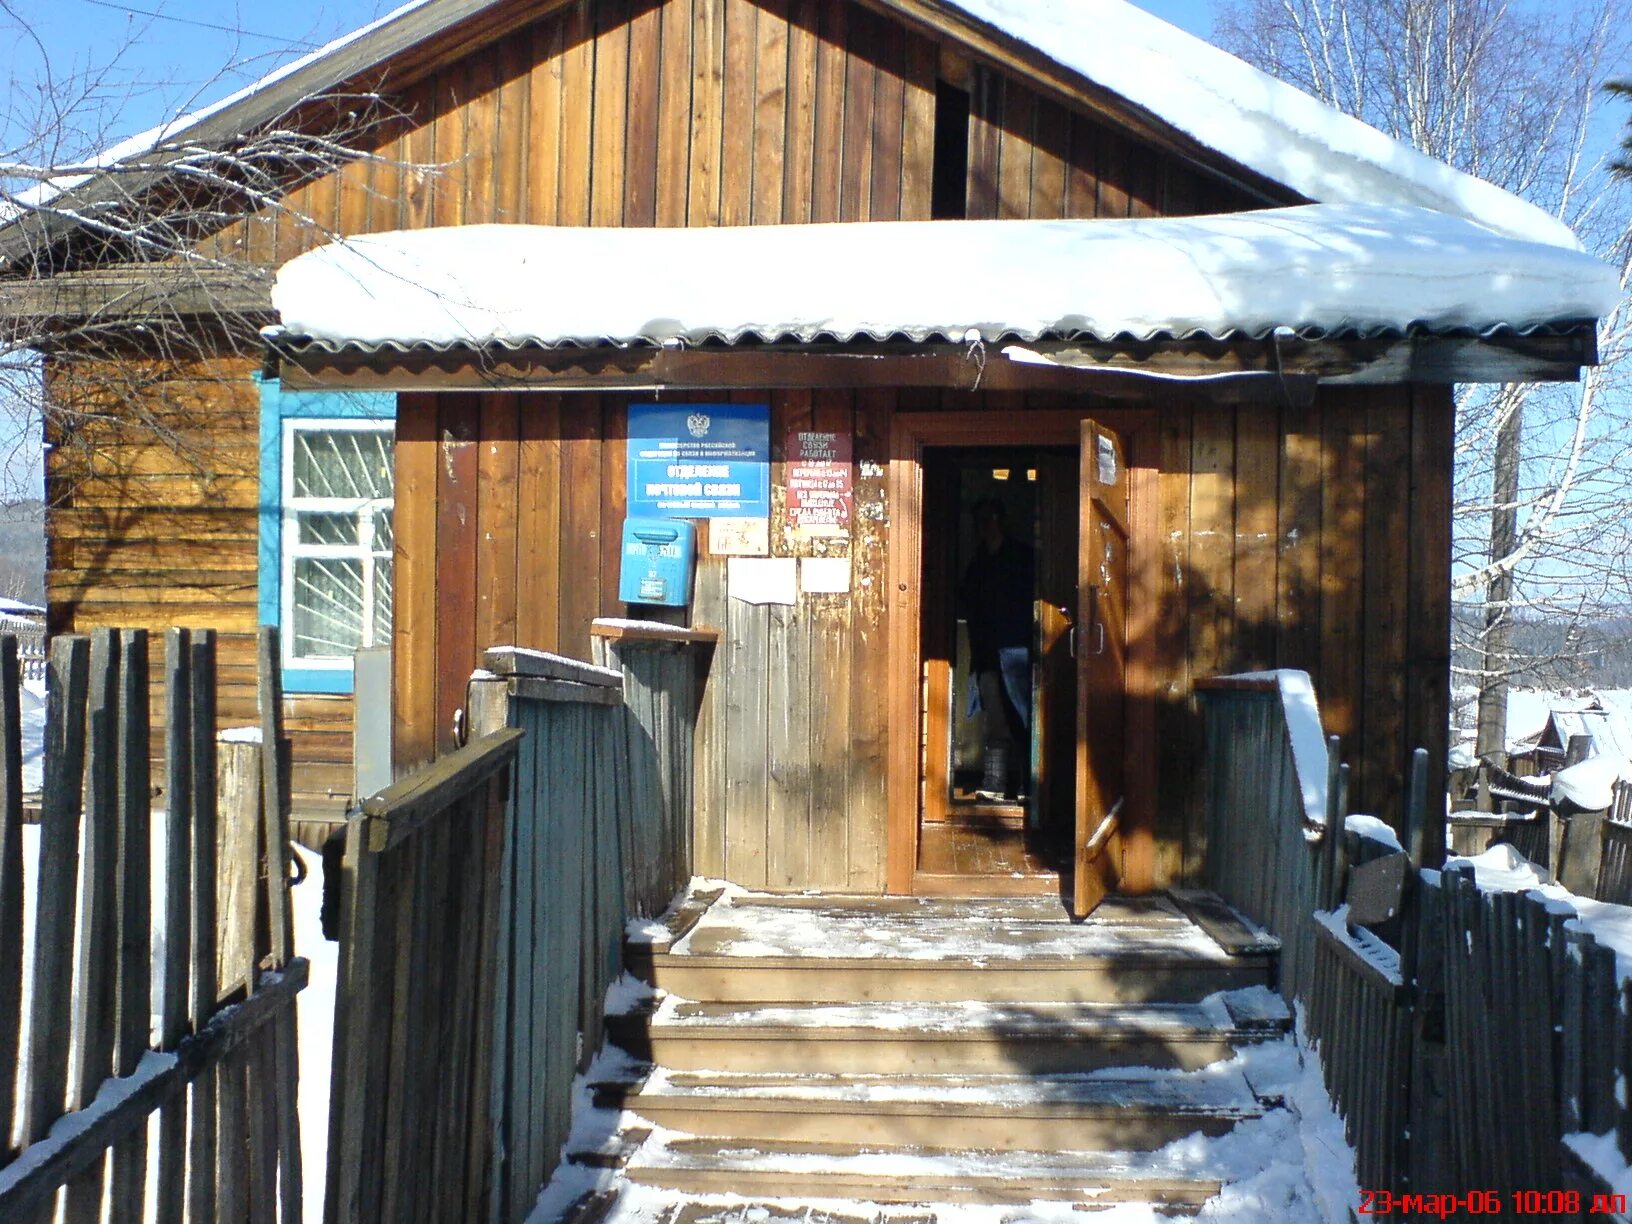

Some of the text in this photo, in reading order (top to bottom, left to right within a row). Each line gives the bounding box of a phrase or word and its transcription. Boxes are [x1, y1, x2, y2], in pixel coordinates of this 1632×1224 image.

[667, 465, 730, 480] ОТДЕЛЕНИЕ
[645, 481, 741, 497] ПОЧТОВОЙ СВЯЗИ
